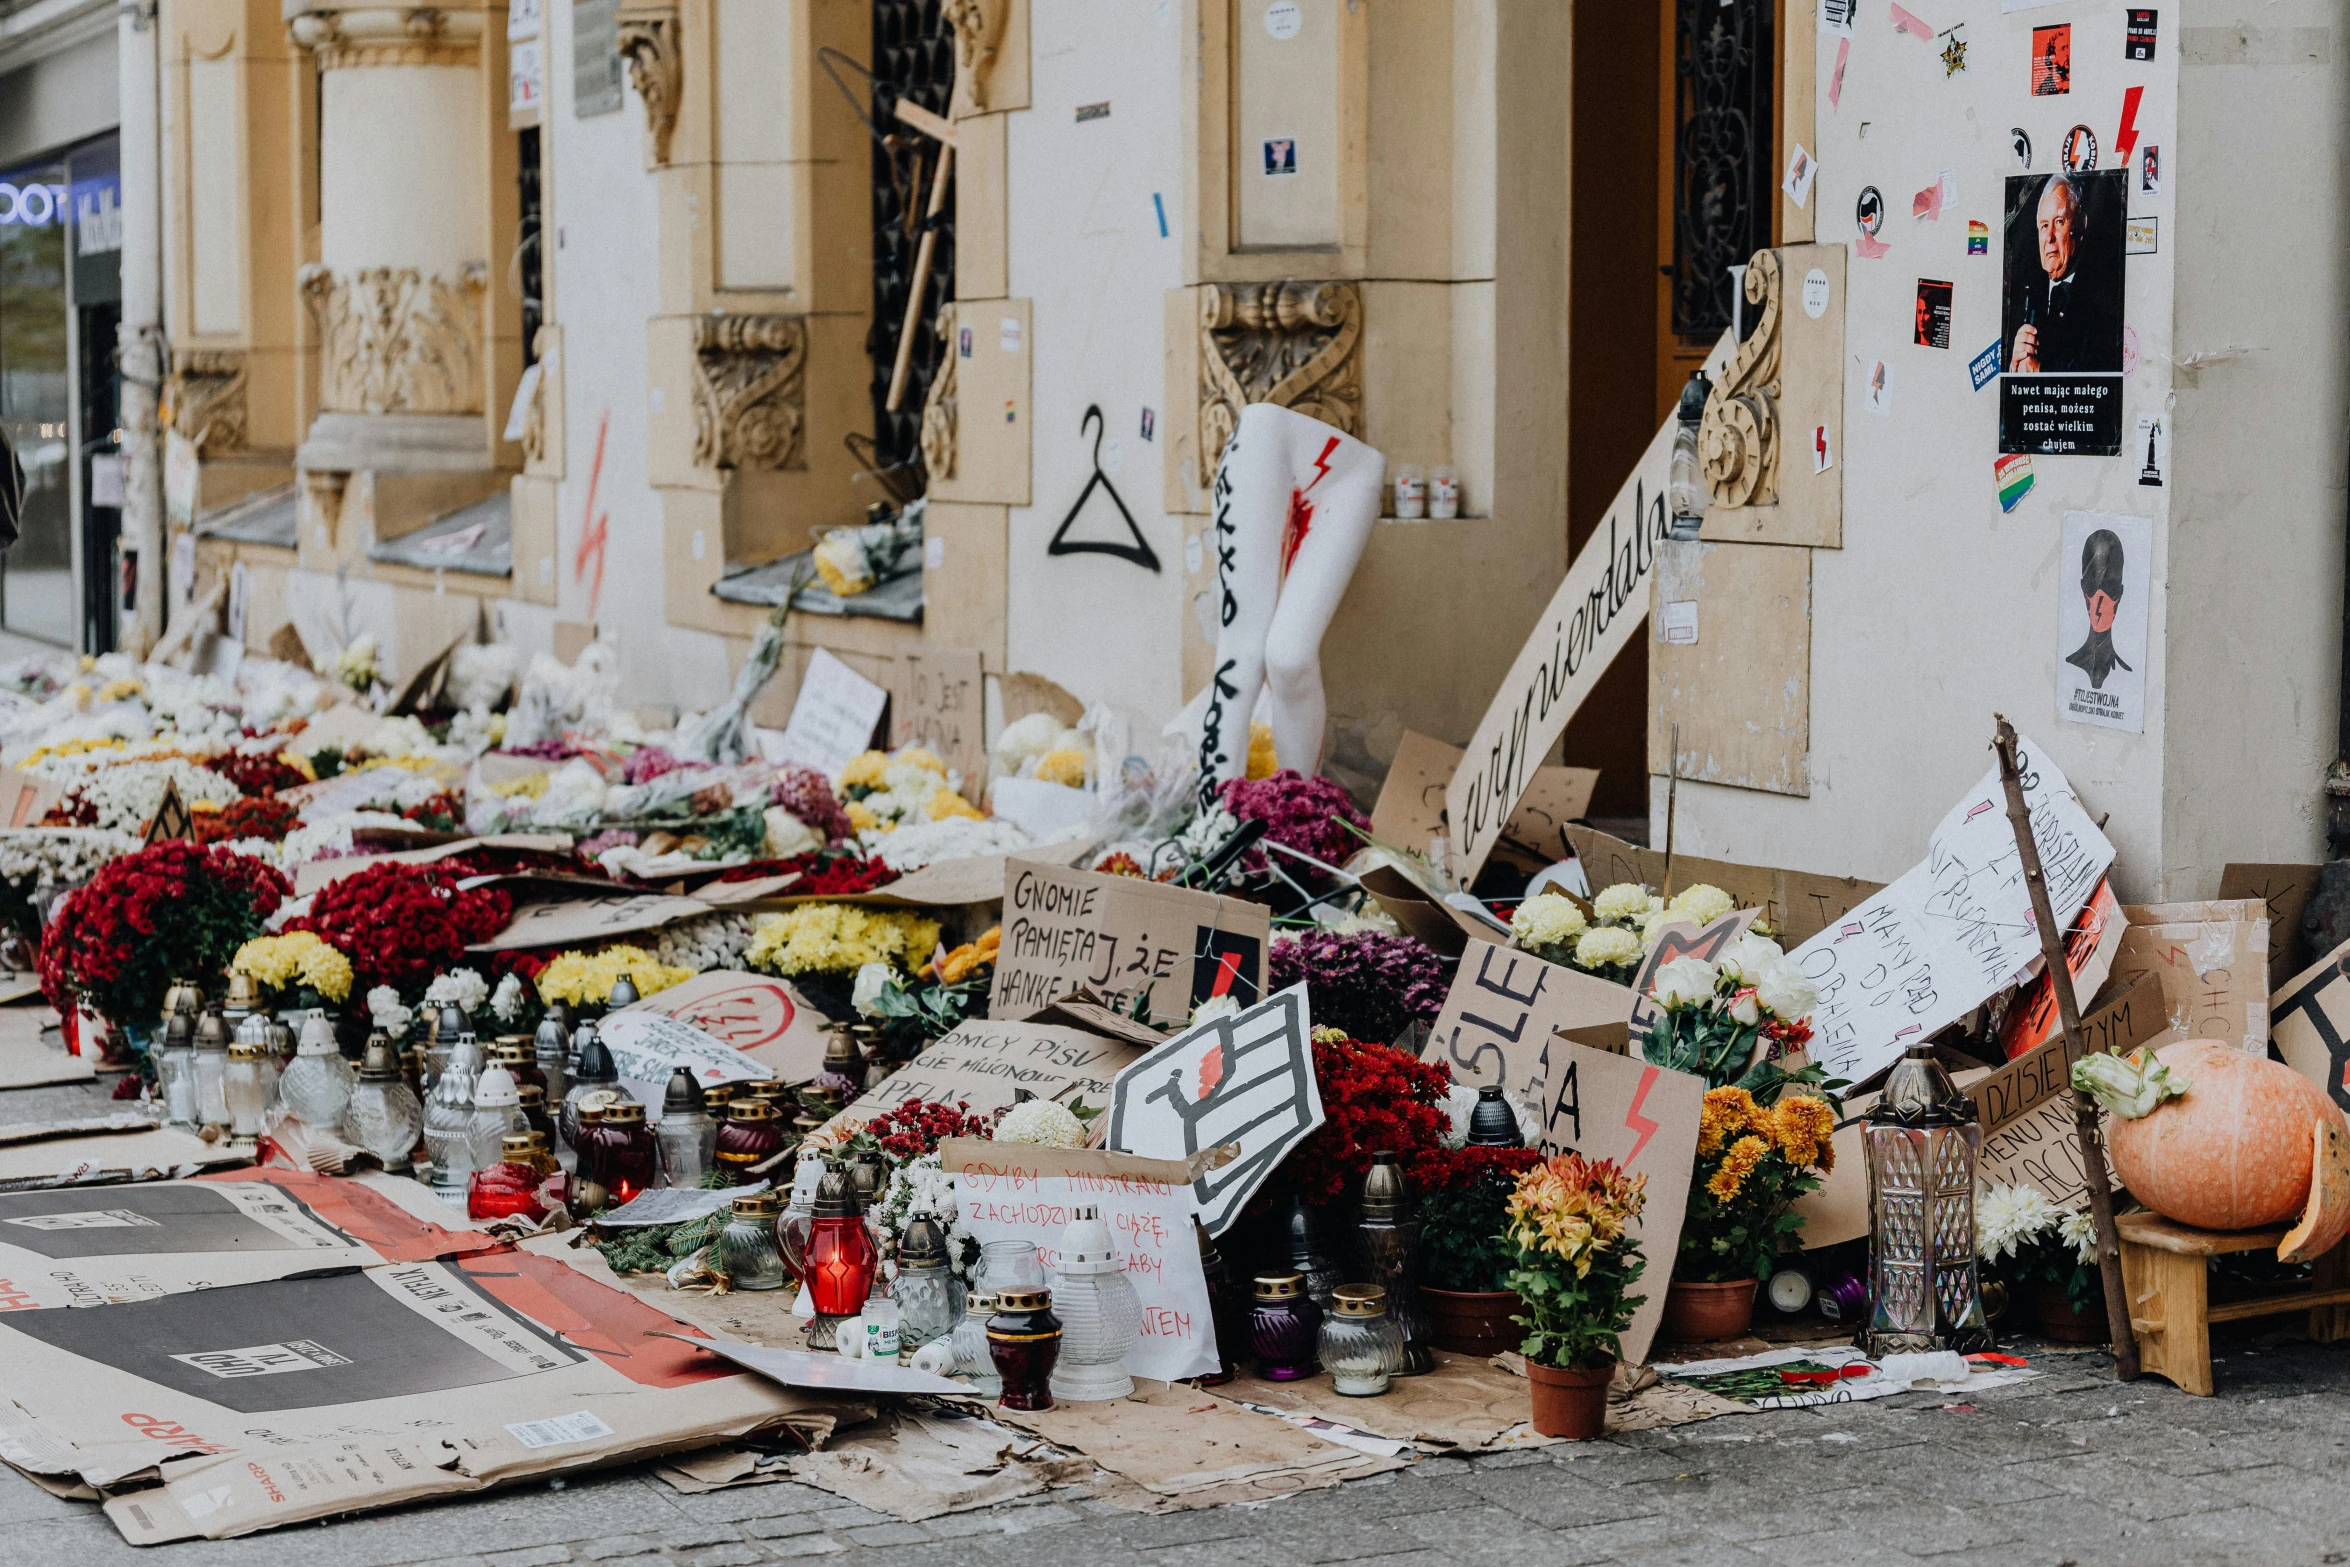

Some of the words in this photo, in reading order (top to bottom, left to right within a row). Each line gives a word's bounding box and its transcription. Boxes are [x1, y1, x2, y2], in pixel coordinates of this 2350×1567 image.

[1971, 349, 1996, 376] NIGDY
[1975, 363, 1997, 385] SAMI.
[2011, 384, 2040, 395] Nawet
[2044, 384, 2070, 398] mając
[2074, 384, 2108, 398] małego
[2023, 402, 2057, 416] penisa,
[2061, 402, 2095, 413] możesz
[2023, 420, 2055, 431] zostać
[2058, 421, 2094, 432] wielkim
[2043, 438, 2076, 452] chujem
[1463, 476, 1670, 856] wypierdala
[2073, 688, 2119, 708] #TOJESTWOJNA
[1014, 870, 1100, 917] GNOMIE
[1864, 904, 1929, 970] MAMY
[1127, 933, 1179, 978] ŻE
[1860, 963, 1896, 1007] DO
[1980, 1118, 2043, 1171] MENU
[963, 1162, 1039, 1193] GDYBY
[1064, 1168, 1173, 1197] MINISTRANCI
[389, 1267, 455, 1301] NETFLIX
[883, 1331, 899, 1339] BISP
[189, 1354, 266, 1378] UHD
[249, 1352, 298, 1366] TV
[121, 1412, 241, 1454] HARP
[383, 1446, 416, 1471] NETFLIX
[247, 1462, 286, 1503] SHARP
